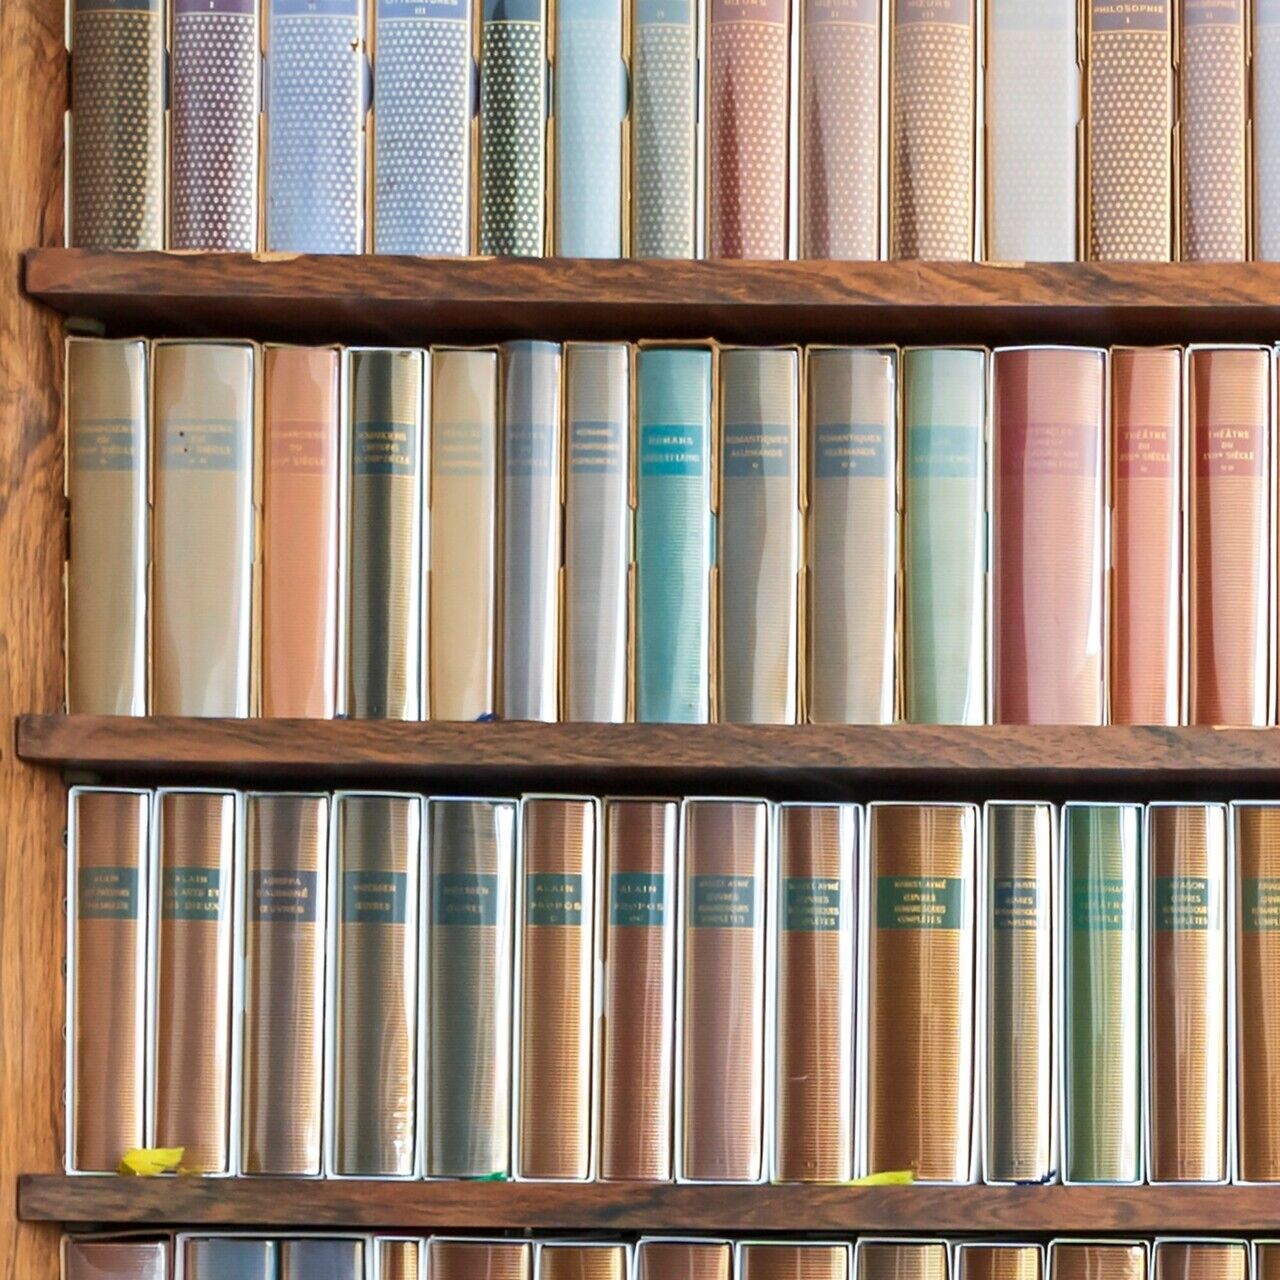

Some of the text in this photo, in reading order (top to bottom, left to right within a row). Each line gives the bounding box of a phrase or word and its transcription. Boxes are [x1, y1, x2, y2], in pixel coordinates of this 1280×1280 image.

[1094, 4, 1164, 14] PHILOSOPHIE
[1208, 428, 1250, 439] THÉÂTRE
[1221, 441, 1233, 449] DU
